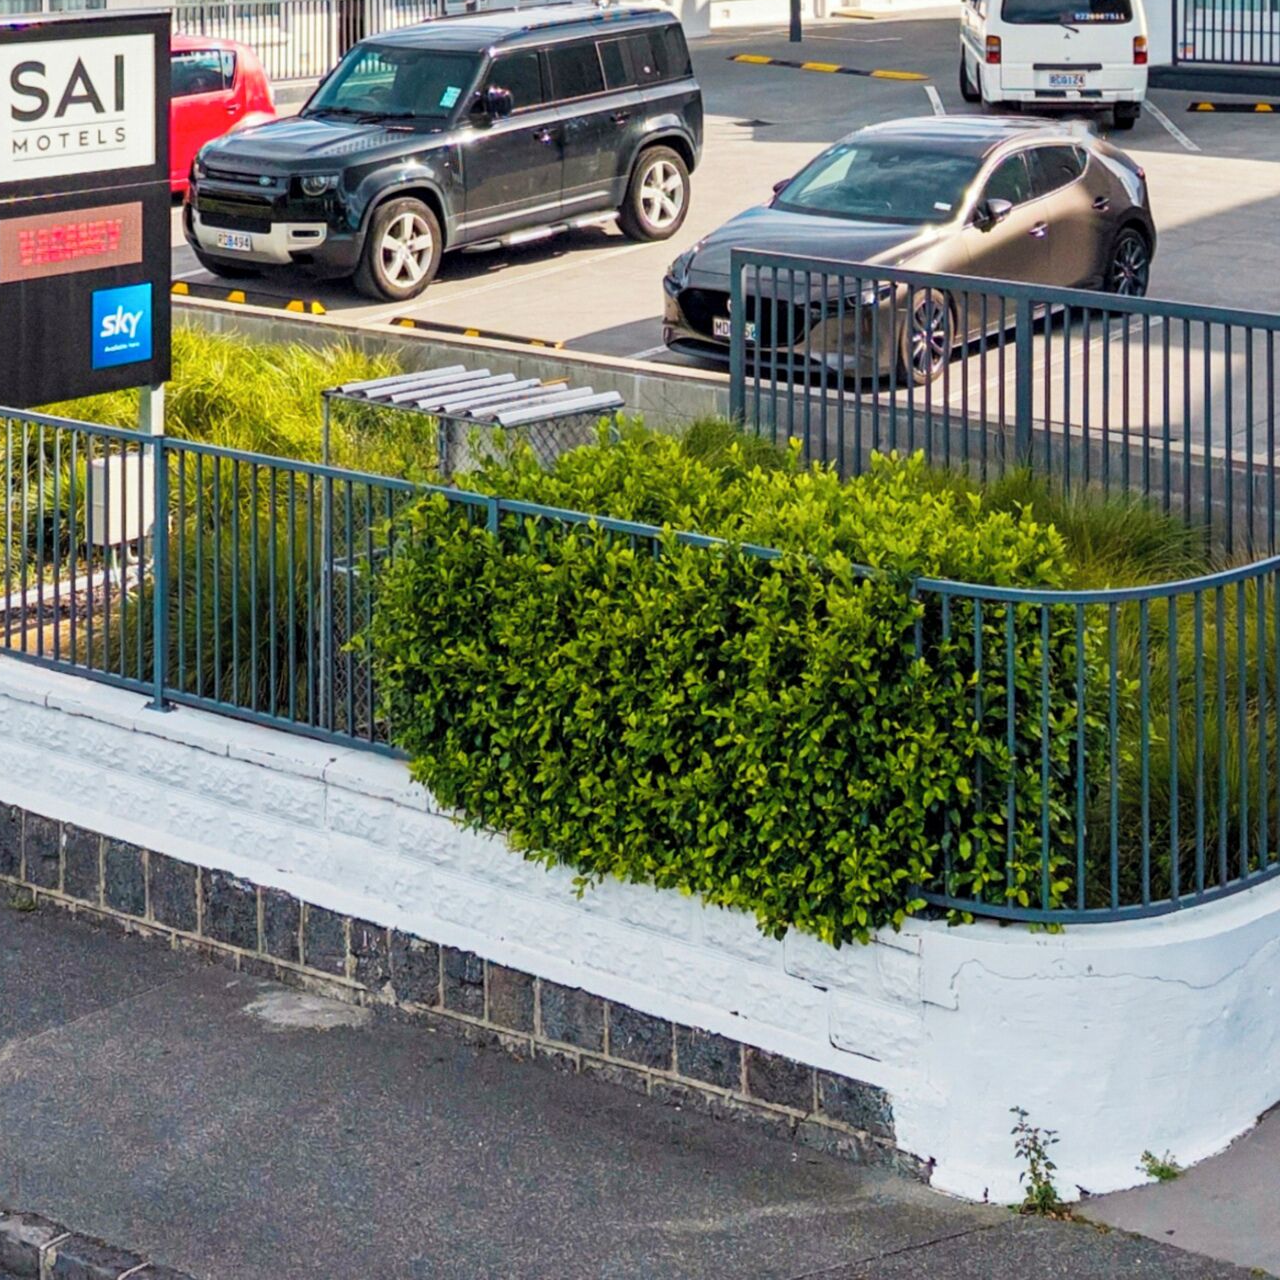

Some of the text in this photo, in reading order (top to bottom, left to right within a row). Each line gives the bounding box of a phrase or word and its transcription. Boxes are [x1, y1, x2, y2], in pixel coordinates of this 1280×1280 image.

[10, 54, 125, 123] SAI
[12, 127, 126, 155] MOTELS
[100, 305, 144, 339] sky
